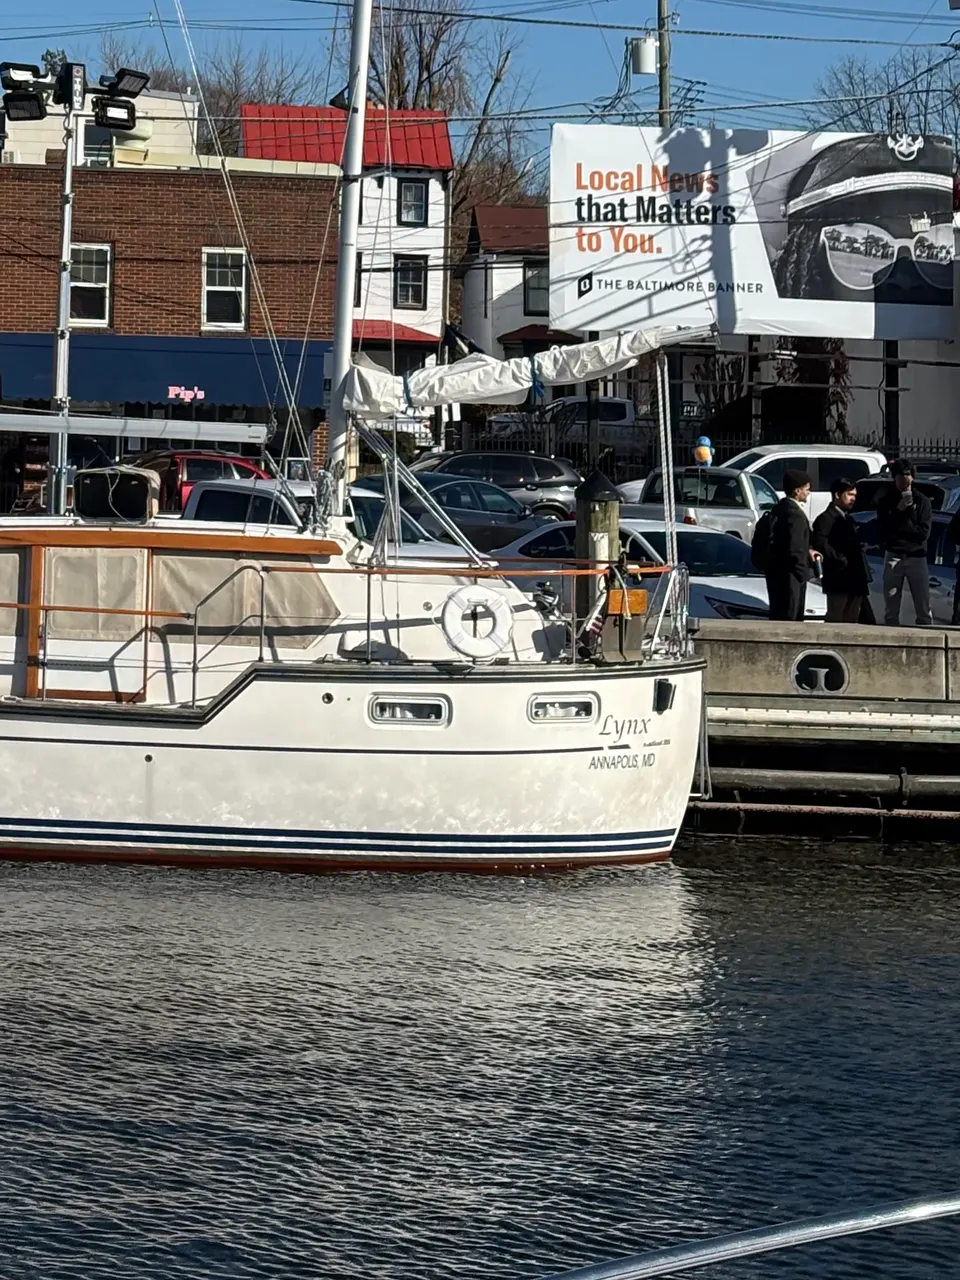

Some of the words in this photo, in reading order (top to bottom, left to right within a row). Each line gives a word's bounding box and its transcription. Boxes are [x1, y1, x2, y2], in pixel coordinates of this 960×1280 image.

[575, 162, 643, 191] Local
[651, 163, 720, 194] News
[575, 194, 628, 223] that
[636, 195, 737, 225] Matters
[576, 226, 602, 252] to
[609, 225, 663, 254] You.
[597, 278, 622, 291] THE
[627, 279, 704, 293] BALTIMORE
[708, 281, 764, 294] BANNER
[168, 385, 205, 403] Pip's
[598, 714, 652, 744] Lynx
[642, 752, 656, 768] MD
